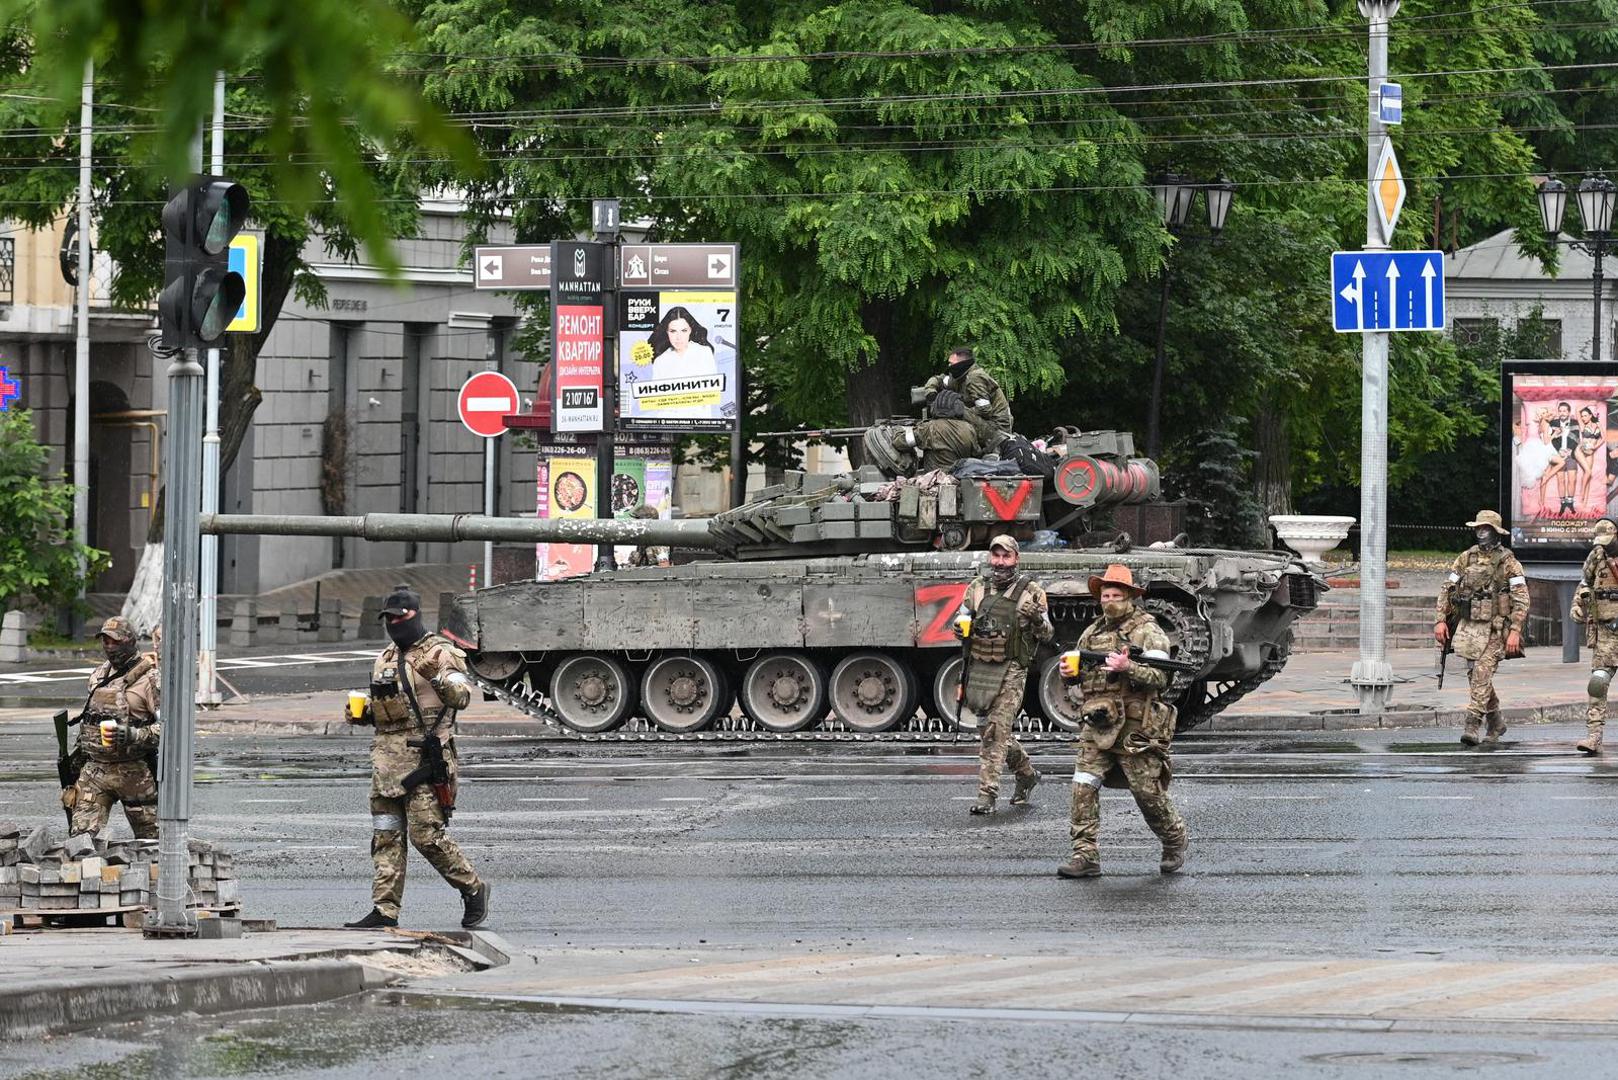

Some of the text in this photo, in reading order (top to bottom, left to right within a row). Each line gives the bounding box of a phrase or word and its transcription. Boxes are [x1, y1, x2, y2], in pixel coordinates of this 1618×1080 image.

[559, 281, 601, 292] MANHATTAN
[628, 298, 651, 306] РУКИ
[628, 313, 646, 321] БАР
[716, 308, 731, 322] 7
[559, 315, 601, 336] РЕМОНТ
[559, 341, 601, 361] КВАРТИР
[638, 378, 720, 395] ИНФИНИТИ
[566, 391, 594, 406] 2 107 167
[982, 480, 1034, 521] V
[915, 583, 969, 644] Z
